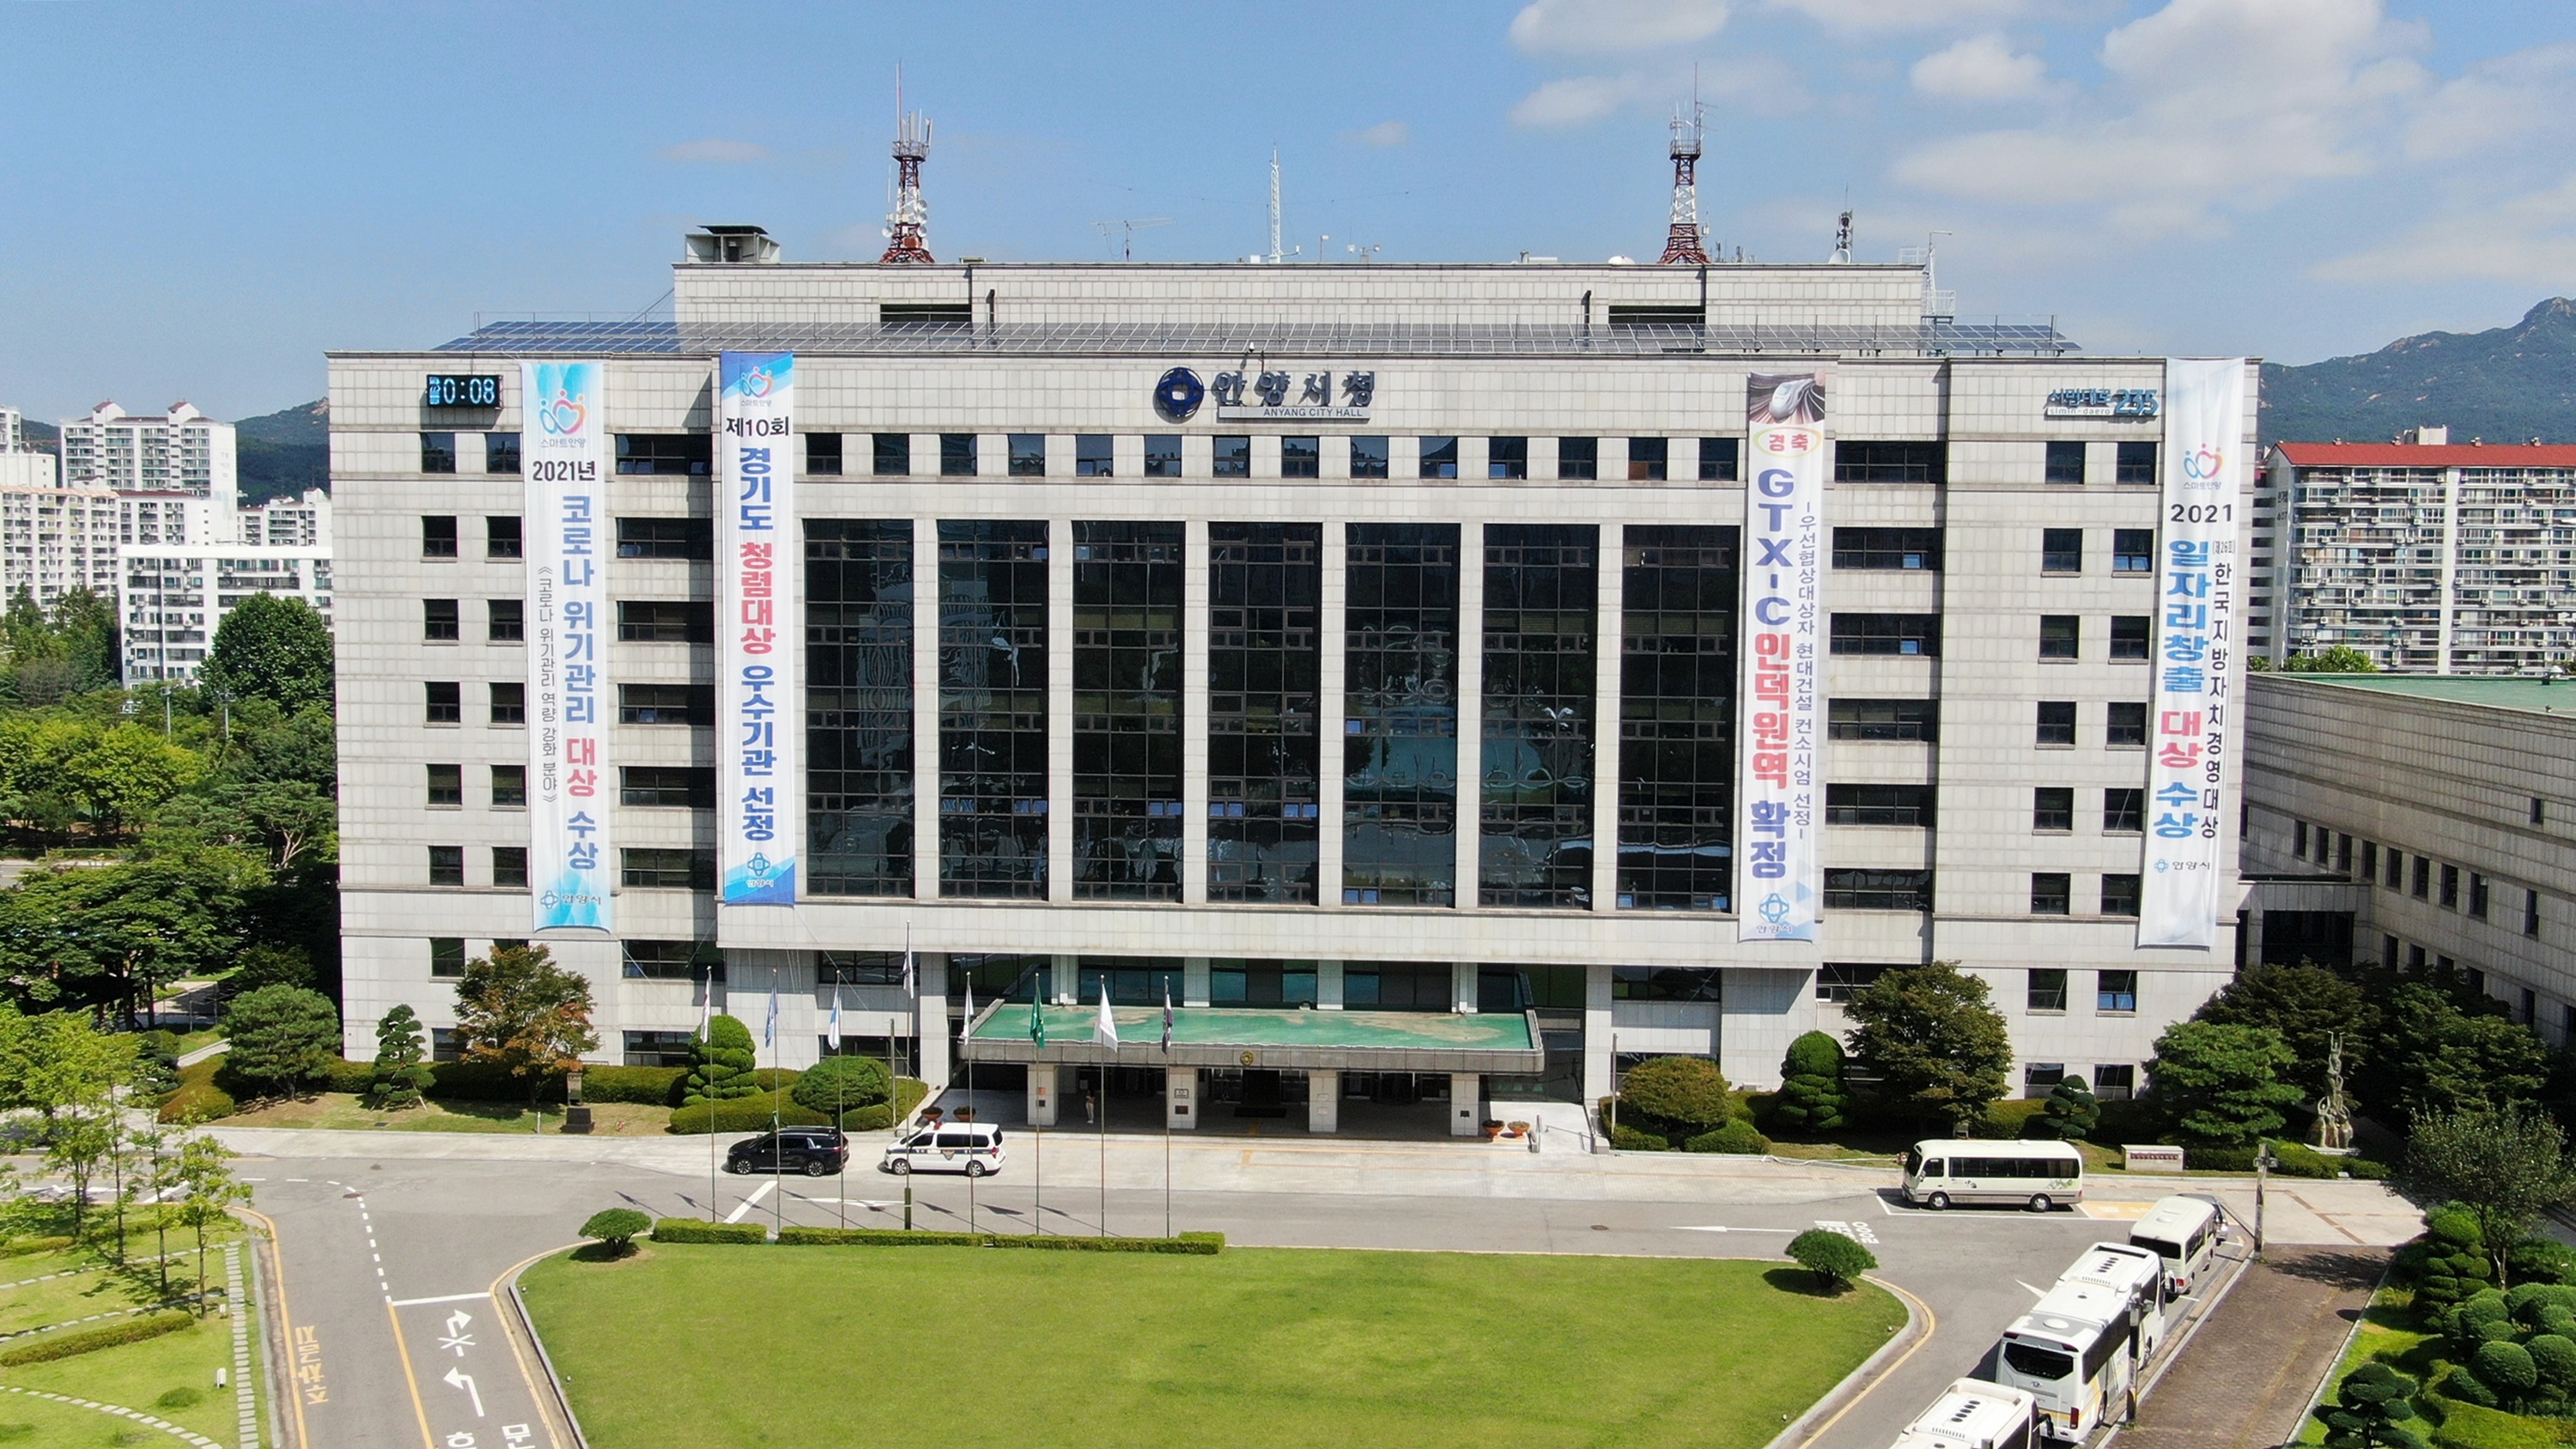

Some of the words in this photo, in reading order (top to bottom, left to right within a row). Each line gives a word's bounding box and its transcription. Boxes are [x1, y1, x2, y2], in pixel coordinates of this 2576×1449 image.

[1215, 370, 1376, 406] 안양시청
[1263, 408, 1306, 417] ANYANG
[1309, 408, 1333, 417] CITY
[1335, 408, 1363, 417] HALL
[2115, 389, 2160, 415] 235
[539, 438, 586, 448] 스마트안양
[726, 416, 790, 438] 제10회
[1769, 433, 1811, 452] 경축
[532, 460, 596, 482] 2021년
[739, 447, 774, 530] 경기도
[562, 495, 594, 587] 코로나
[2170, 503, 2233, 524] 2021
[739, 543, 776, 655] 청렴대상
[2163, 540, 2212, 693] 일자리창출
[539, 628, 556, 688] 위기관리
[563, 601, 597, 724] 위기관리
[1795, 643, 1814, 712] 현대건설
[541, 694, 556, 723] 역량
[741, 665, 778, 776] 우수기관
[542, 729, 557, 757] 강화
[566, 737, 598, 797] 대상
[1793, 718, 1813, 786] 컨소시엄
[2158, 711, 2203, 769] 대상
[741, 786, 775, 841] 선정
[2153, 781, 2199, 839] 수상
[568, 811, 598, 870] 수상
[1750, 800, 1791, 879] 확정
[2172, 860, 2211, 871] 안양시
[562, 894, 602, 906] 안양시
[745, 879, 775, 888] 안양시
[1755, 925, 1794, 934] 안양시
